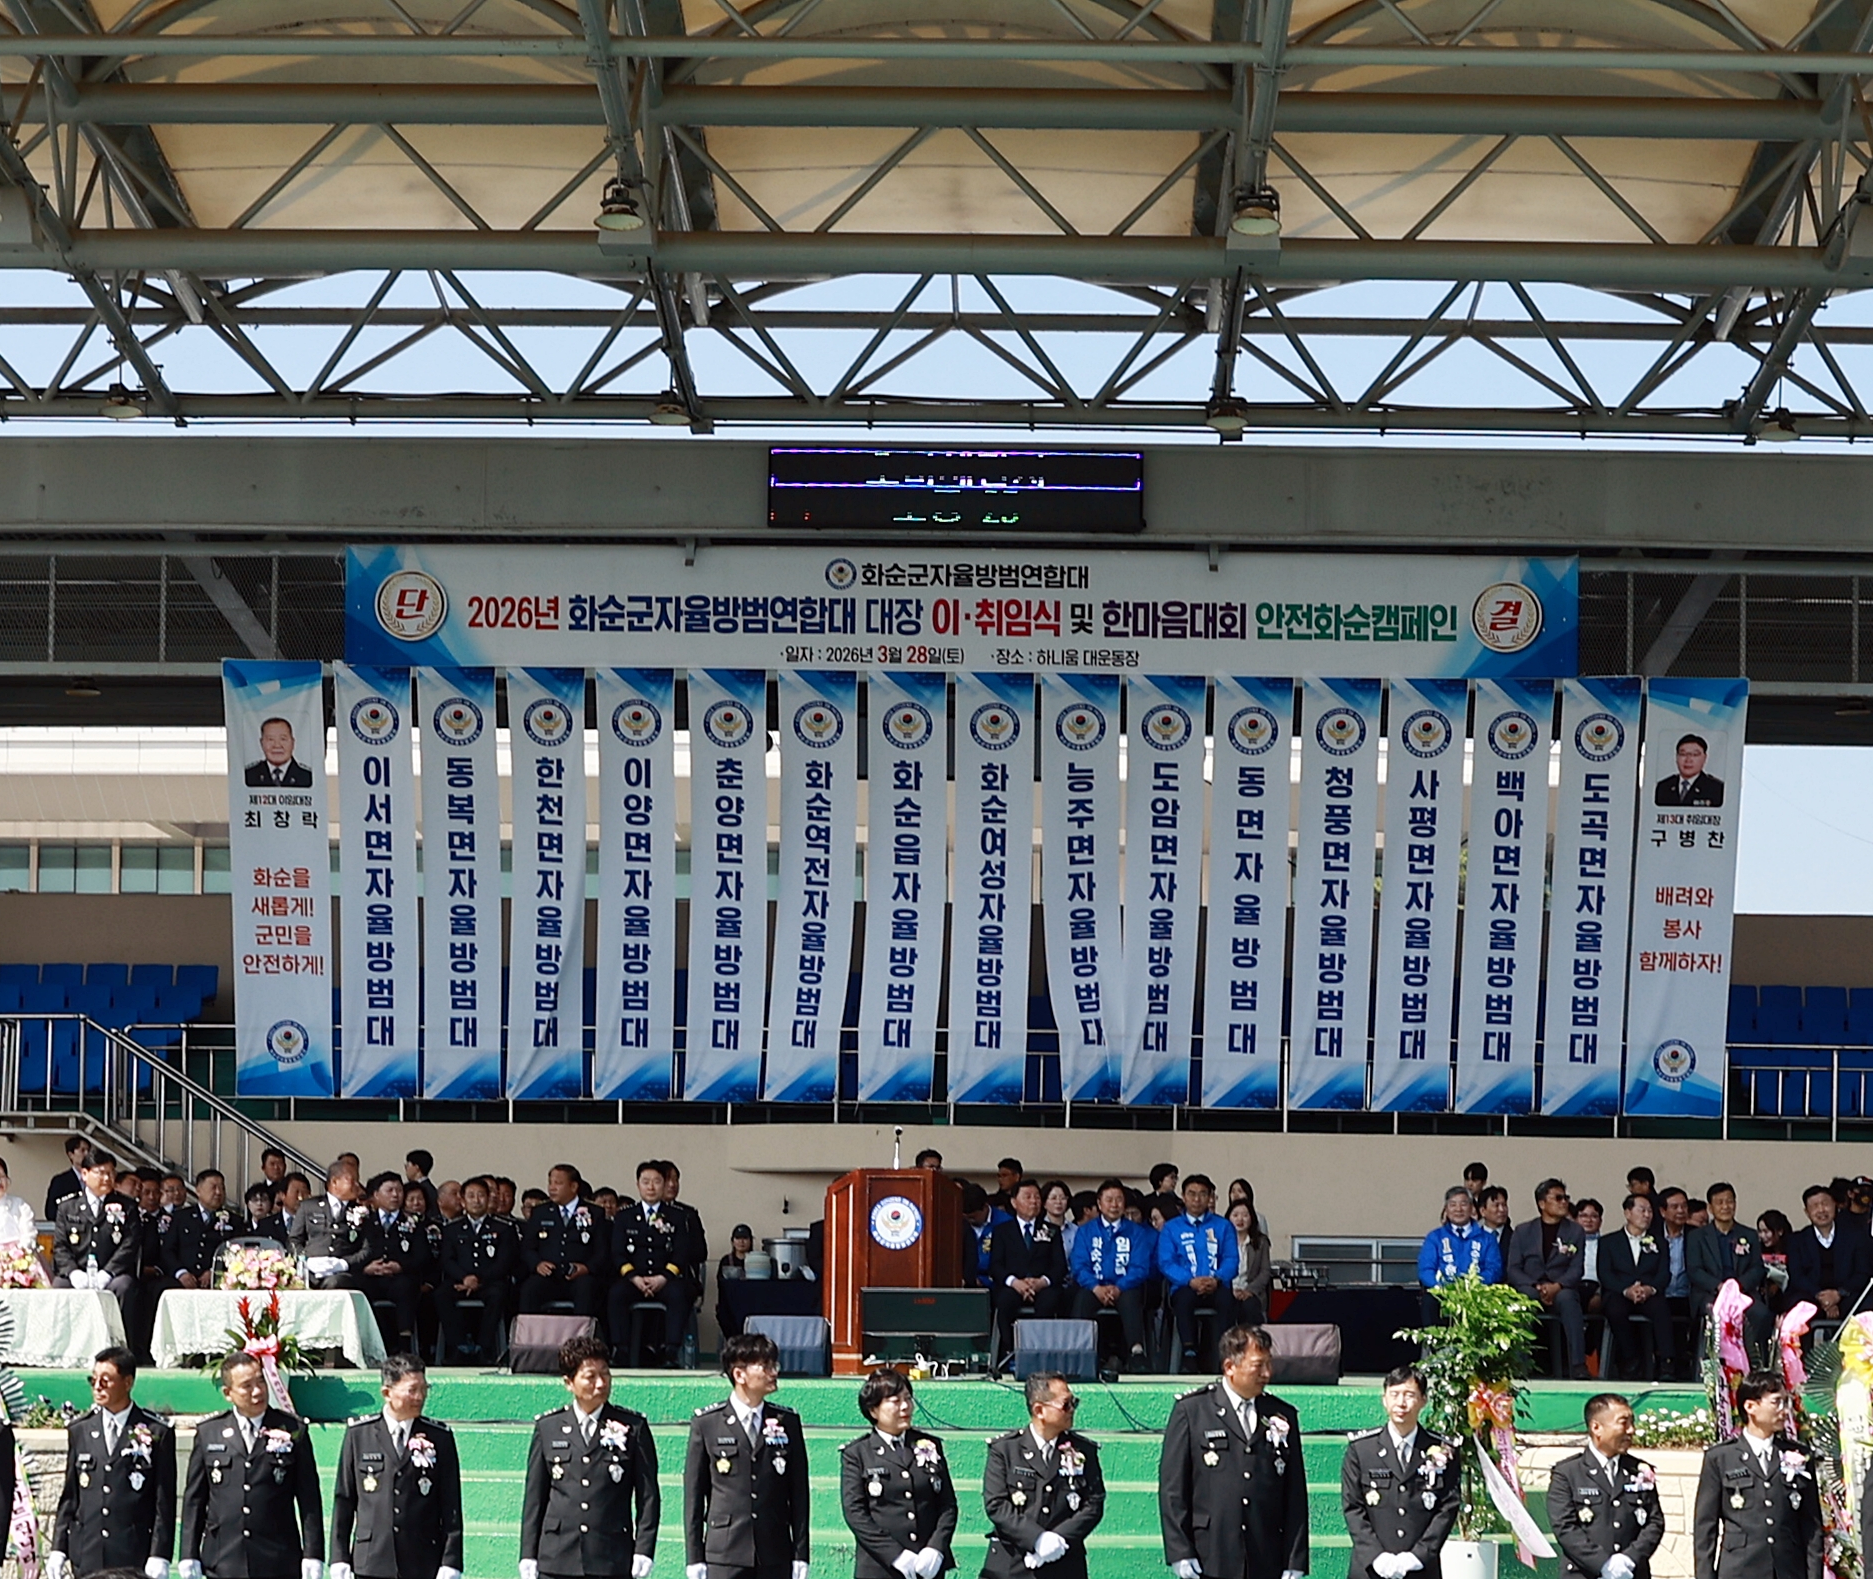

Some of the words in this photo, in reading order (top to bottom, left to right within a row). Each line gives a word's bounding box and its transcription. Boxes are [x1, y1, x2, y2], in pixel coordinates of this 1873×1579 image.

[395, 588, 430, 620] 단
[467, 594, 560, 632] 2026년
[568, 594, 855, 635] 화순군자율방범연합대
[865, 597, 924, 636] 대장
[931, 597, 1062, 638] 이·취임식
[1070, 602, 1094, 636] 및
[1101, 599, 1248, 640] 한마음대회
[1254, 602, 1458, 642] 안전화순캠페인
[825, 645, 874, 664] 2026년
[877, 644, 903, 664] 3월
[906, 644, 965, 666] 28일(토)
[1036, 648, 1080, 667] 하니움
[1082, 649, 1140, 667] 대운동장
[861, 562, 1089, 590] 화순군자율방범연합대
[1489, 598, 1524, 631] 결
[249, 795, 277, 806] 제12대
[251, 895, 314, 918] 새롭게!
[253, 867, 311, 888] 화순을
[255, 925, 312, 947] 군민을
[363, 757, 395, 1050] 이서면자율방범대
[446, 757, 479, 1050] 동복면자율방범대
[533, 757, 567, 1050] 한천면자율방범대
[621, 757, 653, 1050] 이양면자율방범대
[711, 758, 747, 1052] 춘양면자율방범대
[791, 760, 833, 1051] 화순역전자율방범대
[882, 760, 925, 1051] 화순읍자율방범대
[973, 762, 1010, 1052] 화순여성자율방범대
[1065, 761, 1106, 1049] 능주면자율방범대
[1142, 762, 1181, 1054] 도암면자율방범대
[1228, 765, 1266, 1056] 동면자율방범대
[1314, 767, 1354, 1060] 청풍면자율방범대
[1398, 769, 1440, 1062] 사평면자율방범대
[1481, 771, 1527, 1064] 백아면자율방범대
[1568, 773, 1611, 1067] 도곡면자율방범대
[1655, 886, 1714, 908] 배려와
[1656, 814, 1684, 826] 제13대
[1686, 814, 1721, 826] 취임대장
[1662, 919, 1702, 940] 봉사
[243, 954, 324, 976] 안전하게!
[1639, 951, 1722, 974] 함께하자!
